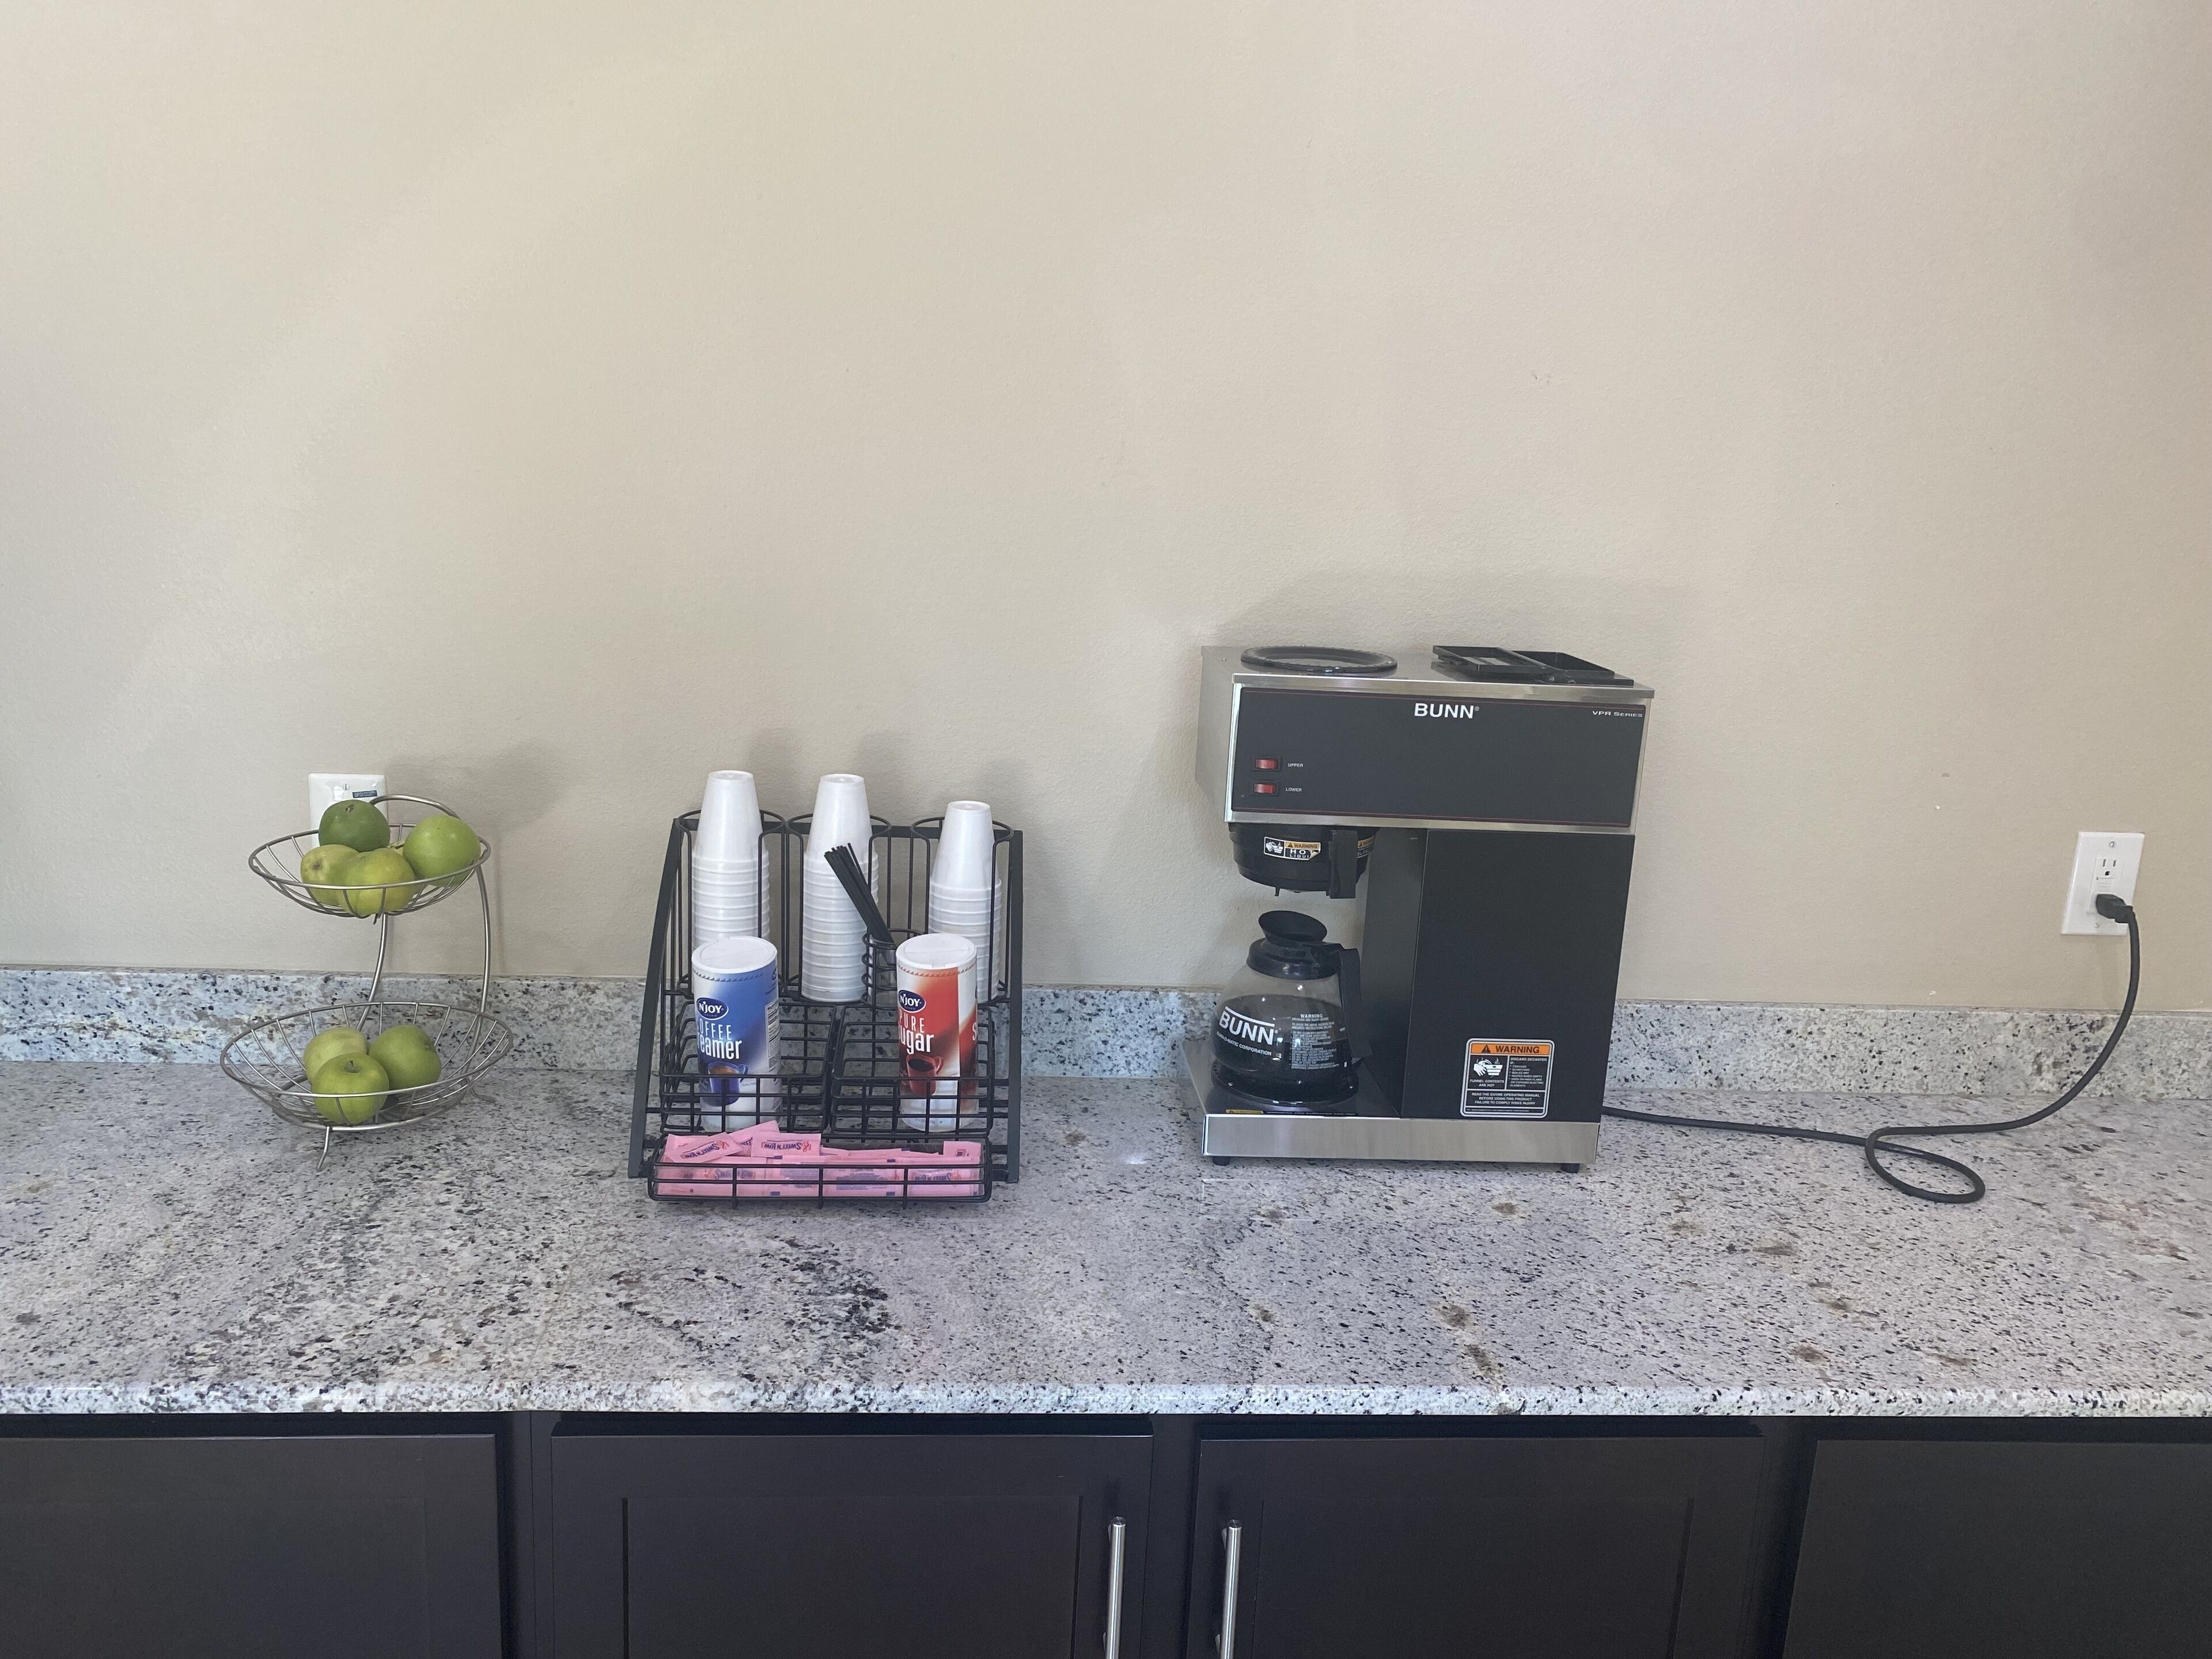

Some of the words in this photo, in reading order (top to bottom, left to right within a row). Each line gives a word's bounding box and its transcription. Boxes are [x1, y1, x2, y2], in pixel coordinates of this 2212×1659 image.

[1414, 702, 1475, 719] BUNN
[697, 1018, 732, 1041] OFFEE
[899, 1009, 925, 1033] PURE
[1219, 1010, 1275, 1046] BUNN
[697, 1031, 743, 1060] reamer
[898, 1021, 934, 1055] ugar
[1239, 1043, 1272, 1056] CORPORATION
[1495, 1045, 1540, 1054] WARNING
